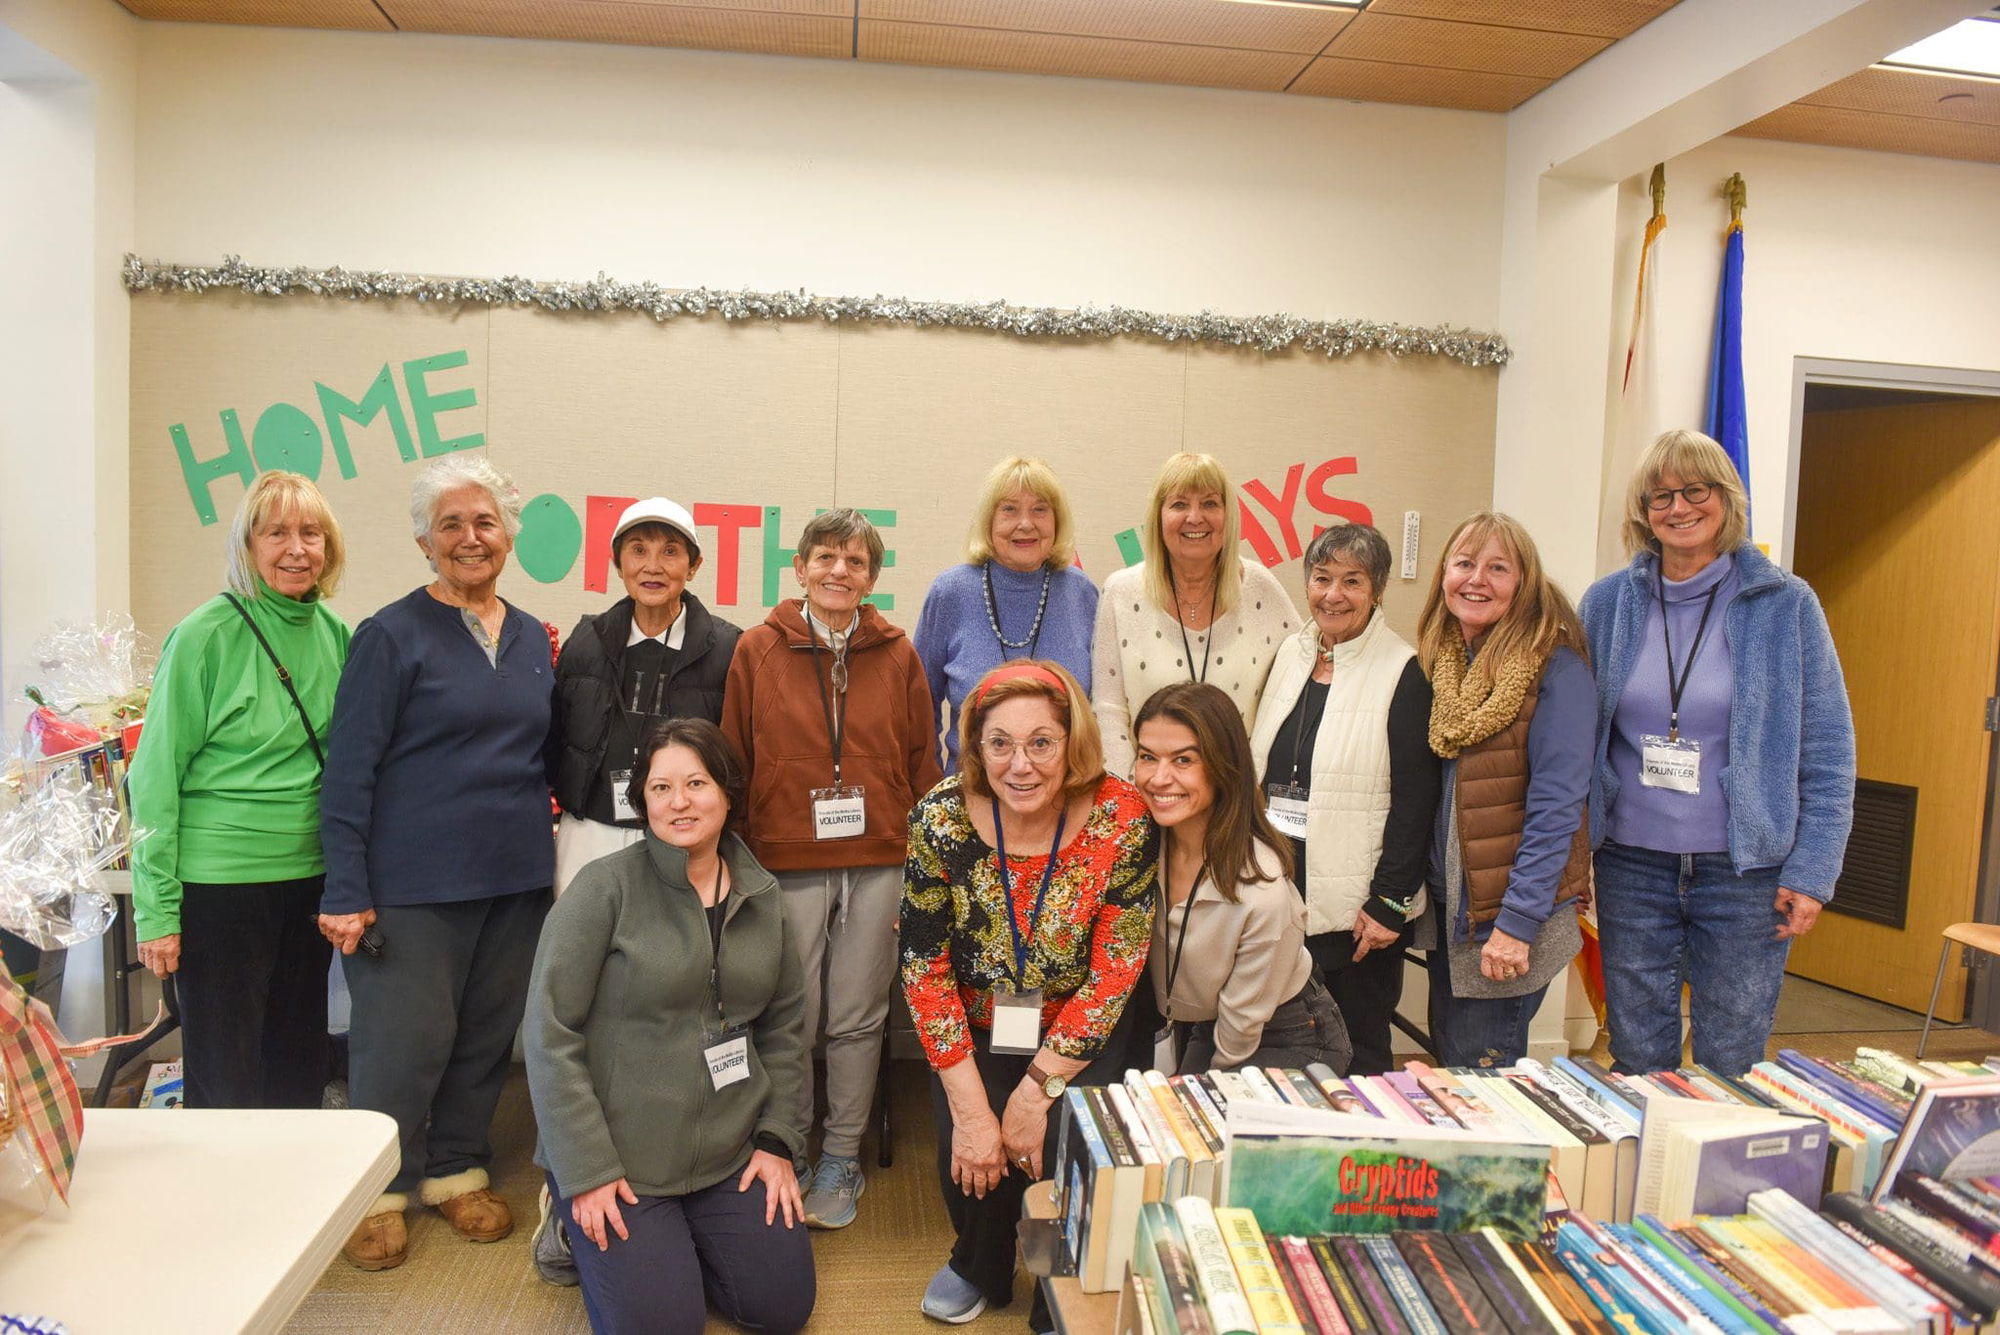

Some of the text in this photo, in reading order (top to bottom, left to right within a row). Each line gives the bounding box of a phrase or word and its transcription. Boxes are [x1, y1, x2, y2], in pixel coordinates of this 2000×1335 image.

[168, 350, 485, 526] HOME
[1646, 765, 1695, 778] VOLUNTEER
[819, 814, 862, 825] VOLUNTEER
[1339, 1156, 1439, 1203] Cryptids
